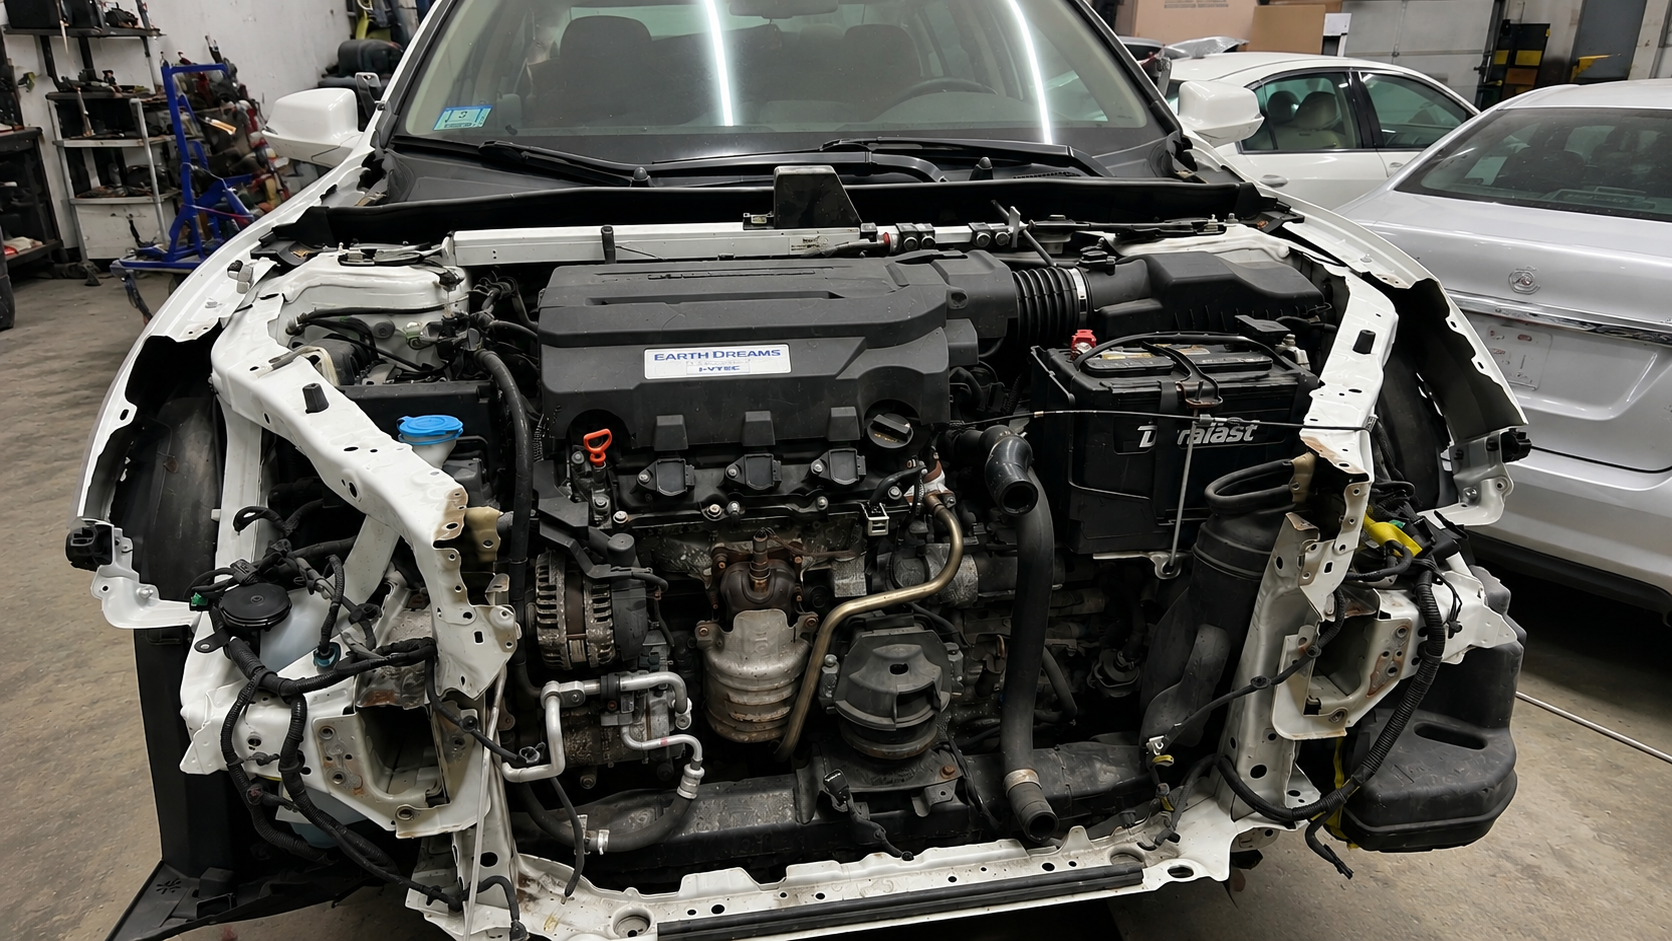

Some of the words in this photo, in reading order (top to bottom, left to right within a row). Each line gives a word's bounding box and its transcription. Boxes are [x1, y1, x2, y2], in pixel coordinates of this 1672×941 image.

[654, 352, 709, 361] EARTH
[713, 349, 781, 359] DREAMS
[1137, 421, 1259, 448] Dralast
